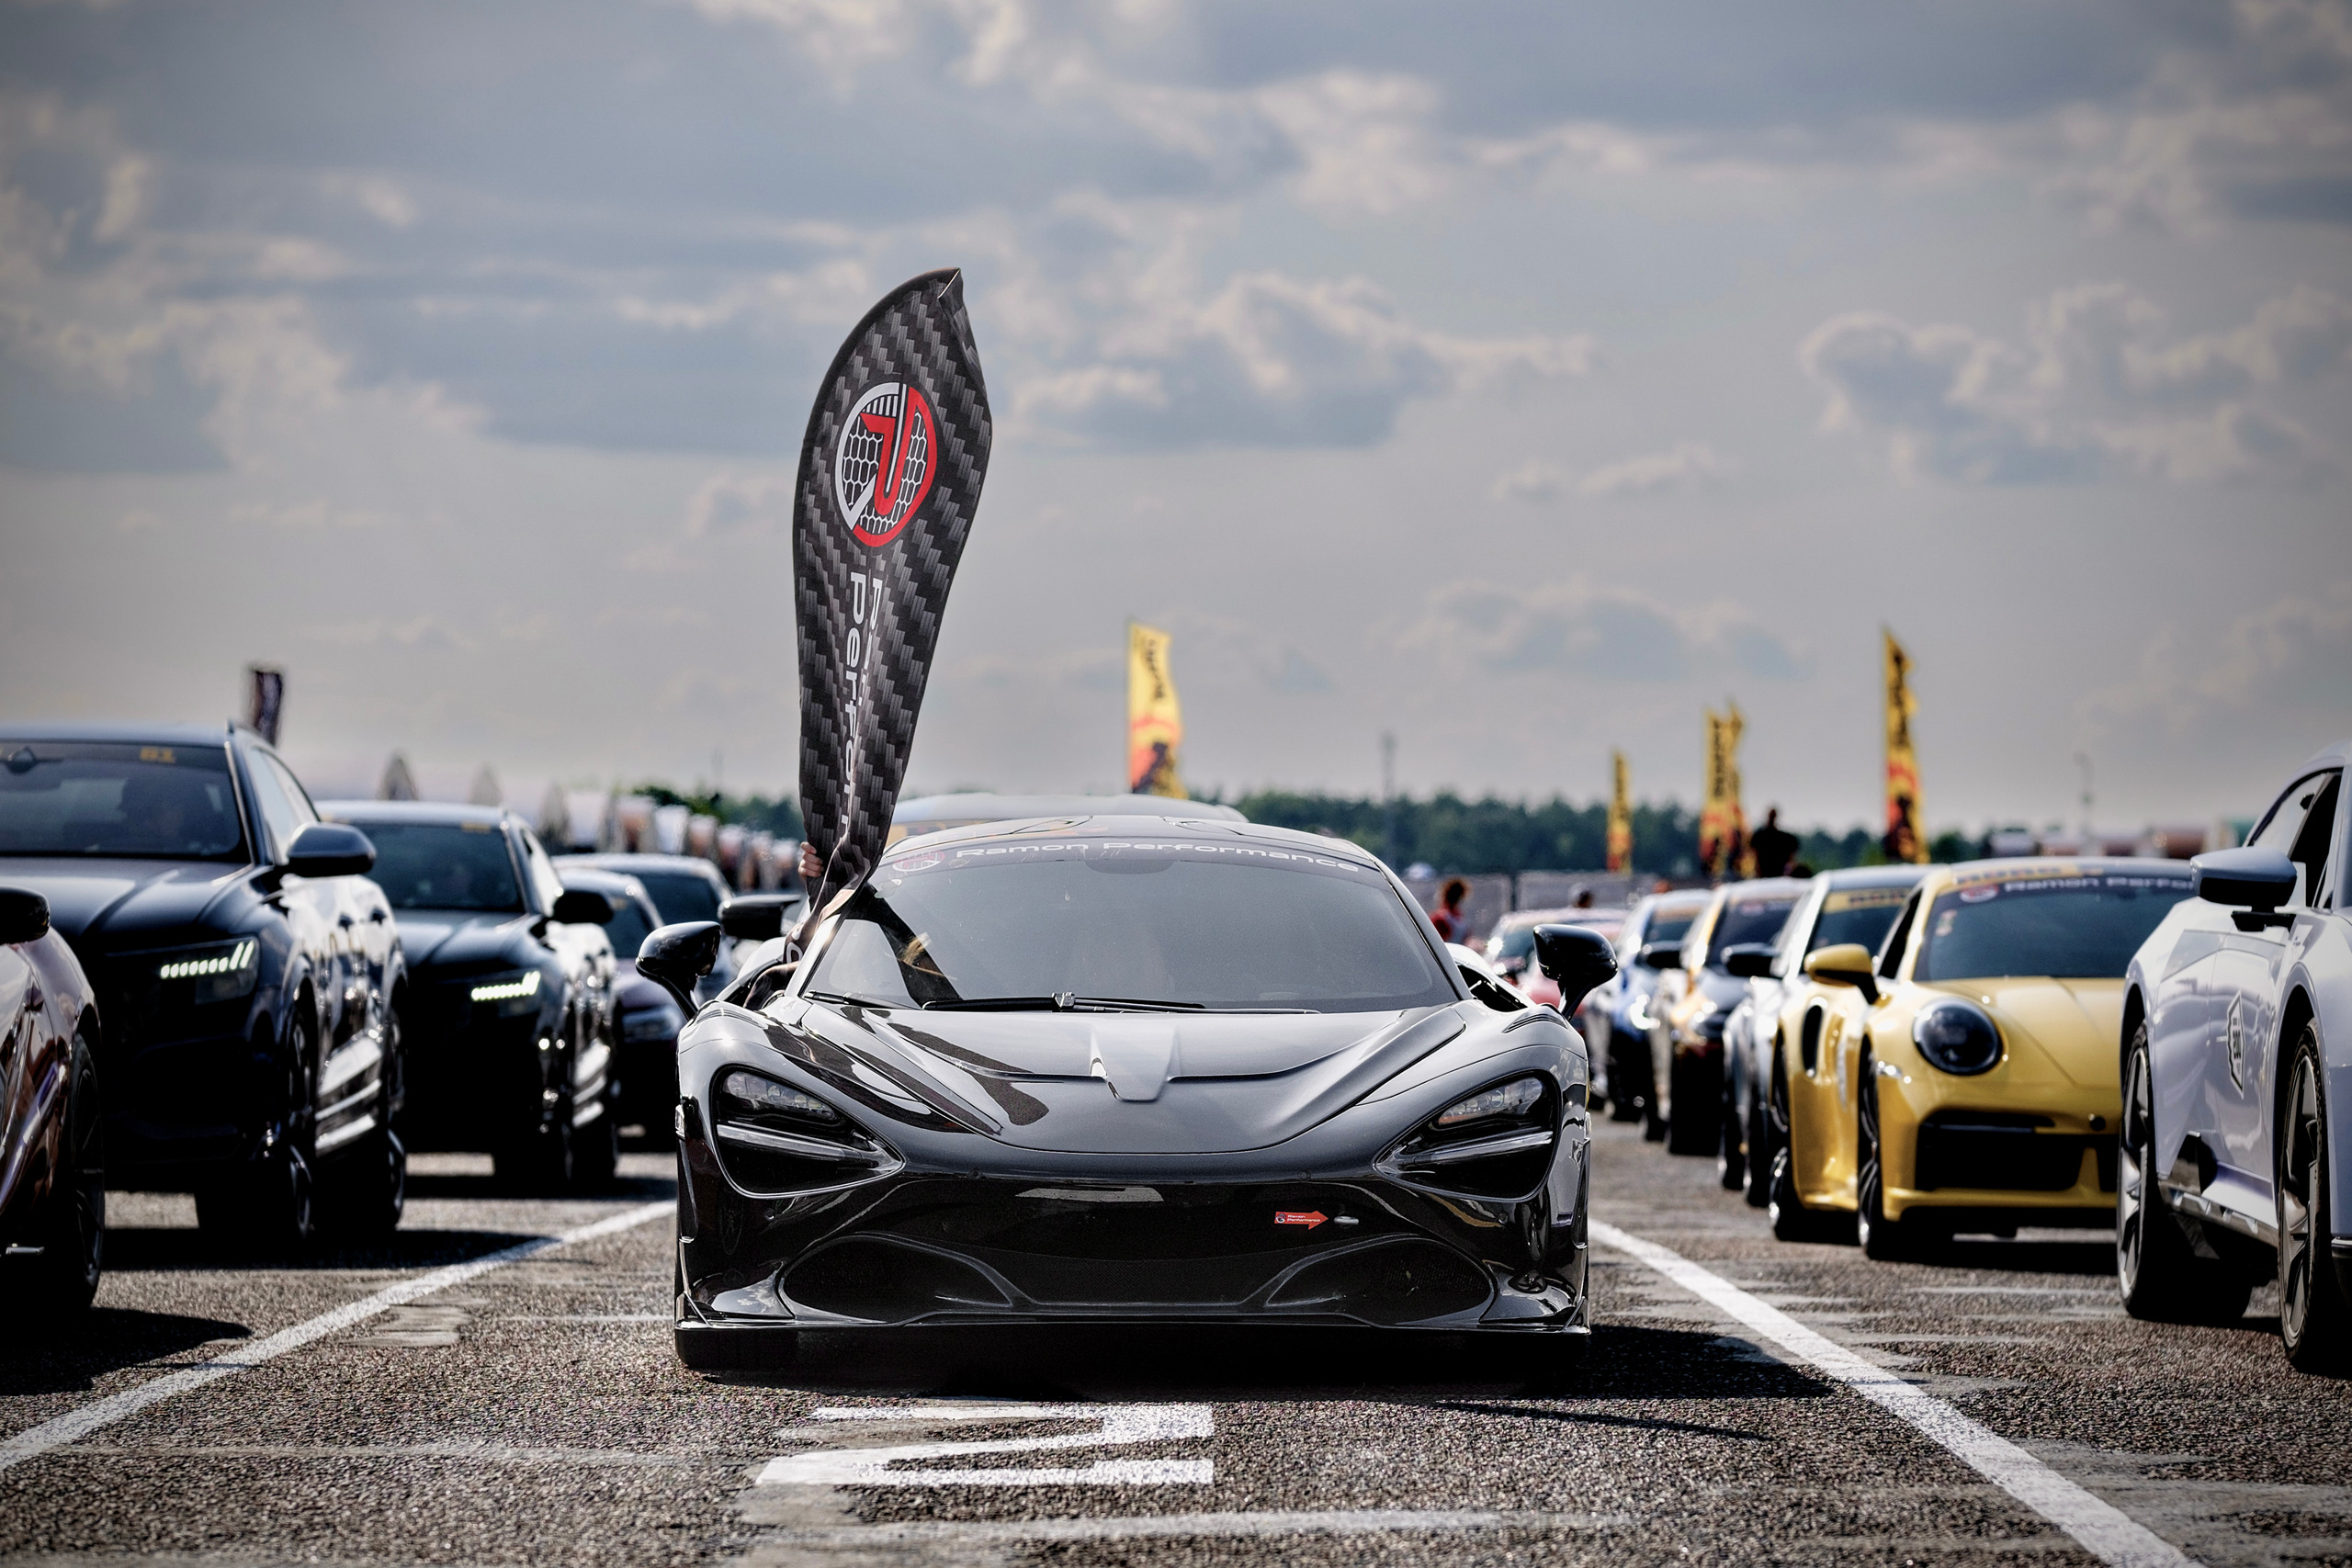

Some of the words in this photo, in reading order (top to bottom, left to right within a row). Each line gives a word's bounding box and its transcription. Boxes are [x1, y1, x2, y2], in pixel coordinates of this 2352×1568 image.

[956, 842, 1090, 858] Ramon
[1102, 841, 1360, 873] Performance
[2004, 876, 2100, 893] Ramon
